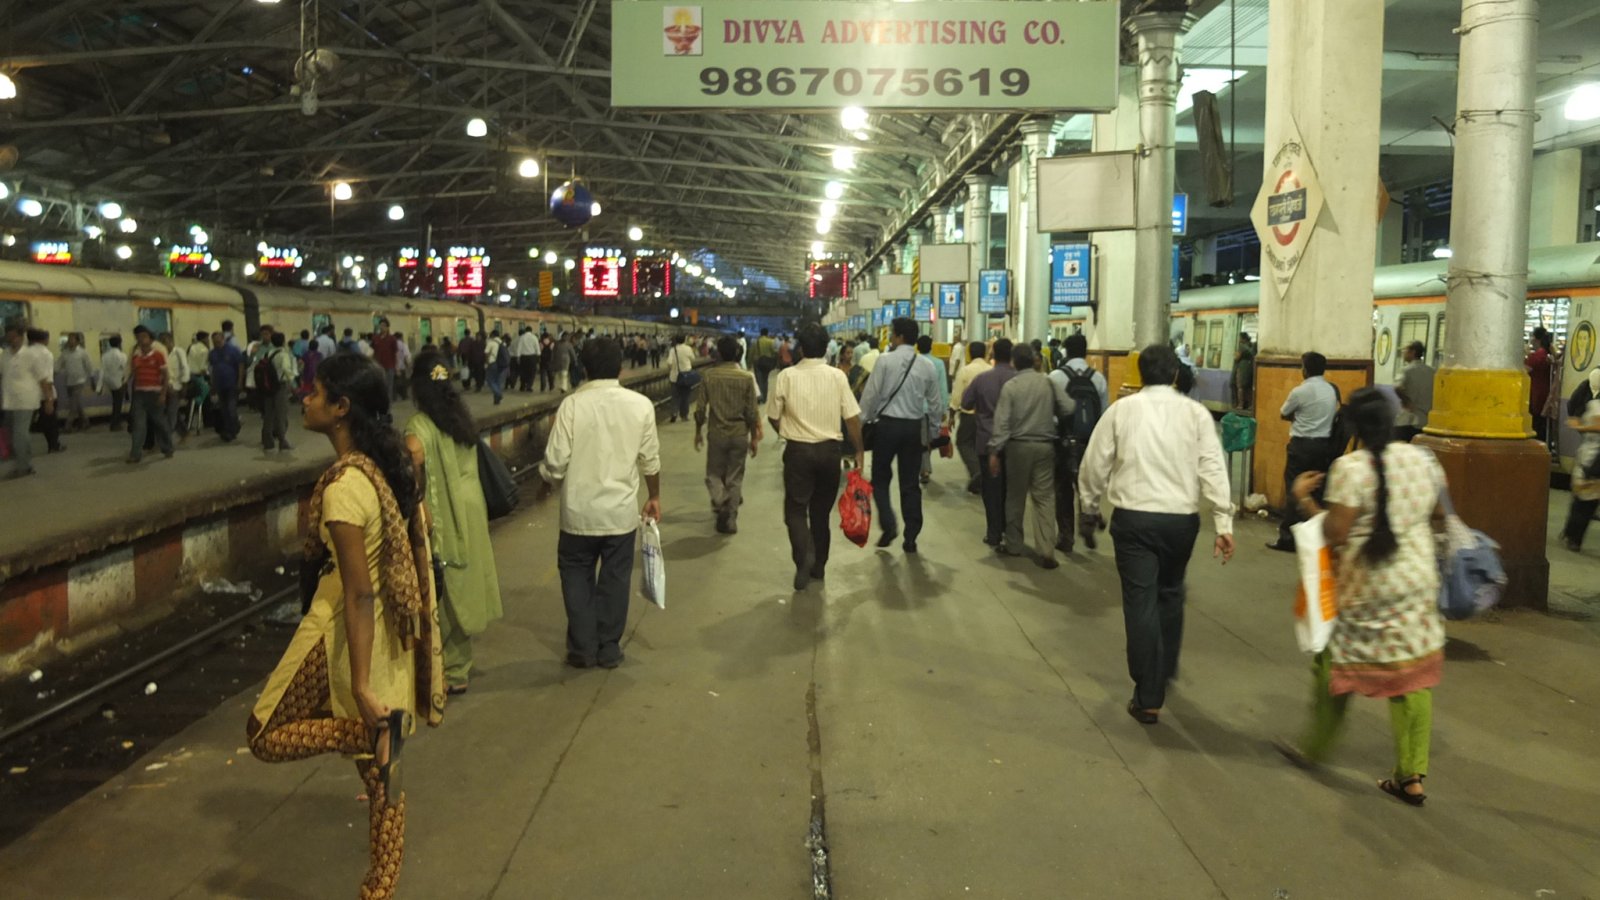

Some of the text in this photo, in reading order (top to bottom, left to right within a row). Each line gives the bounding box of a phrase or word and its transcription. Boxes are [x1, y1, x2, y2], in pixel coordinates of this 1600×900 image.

[724, 20, 1065, 44] DIVYA ADVERTISING CO.
[700, 67, 1031, 96] 9867075619
